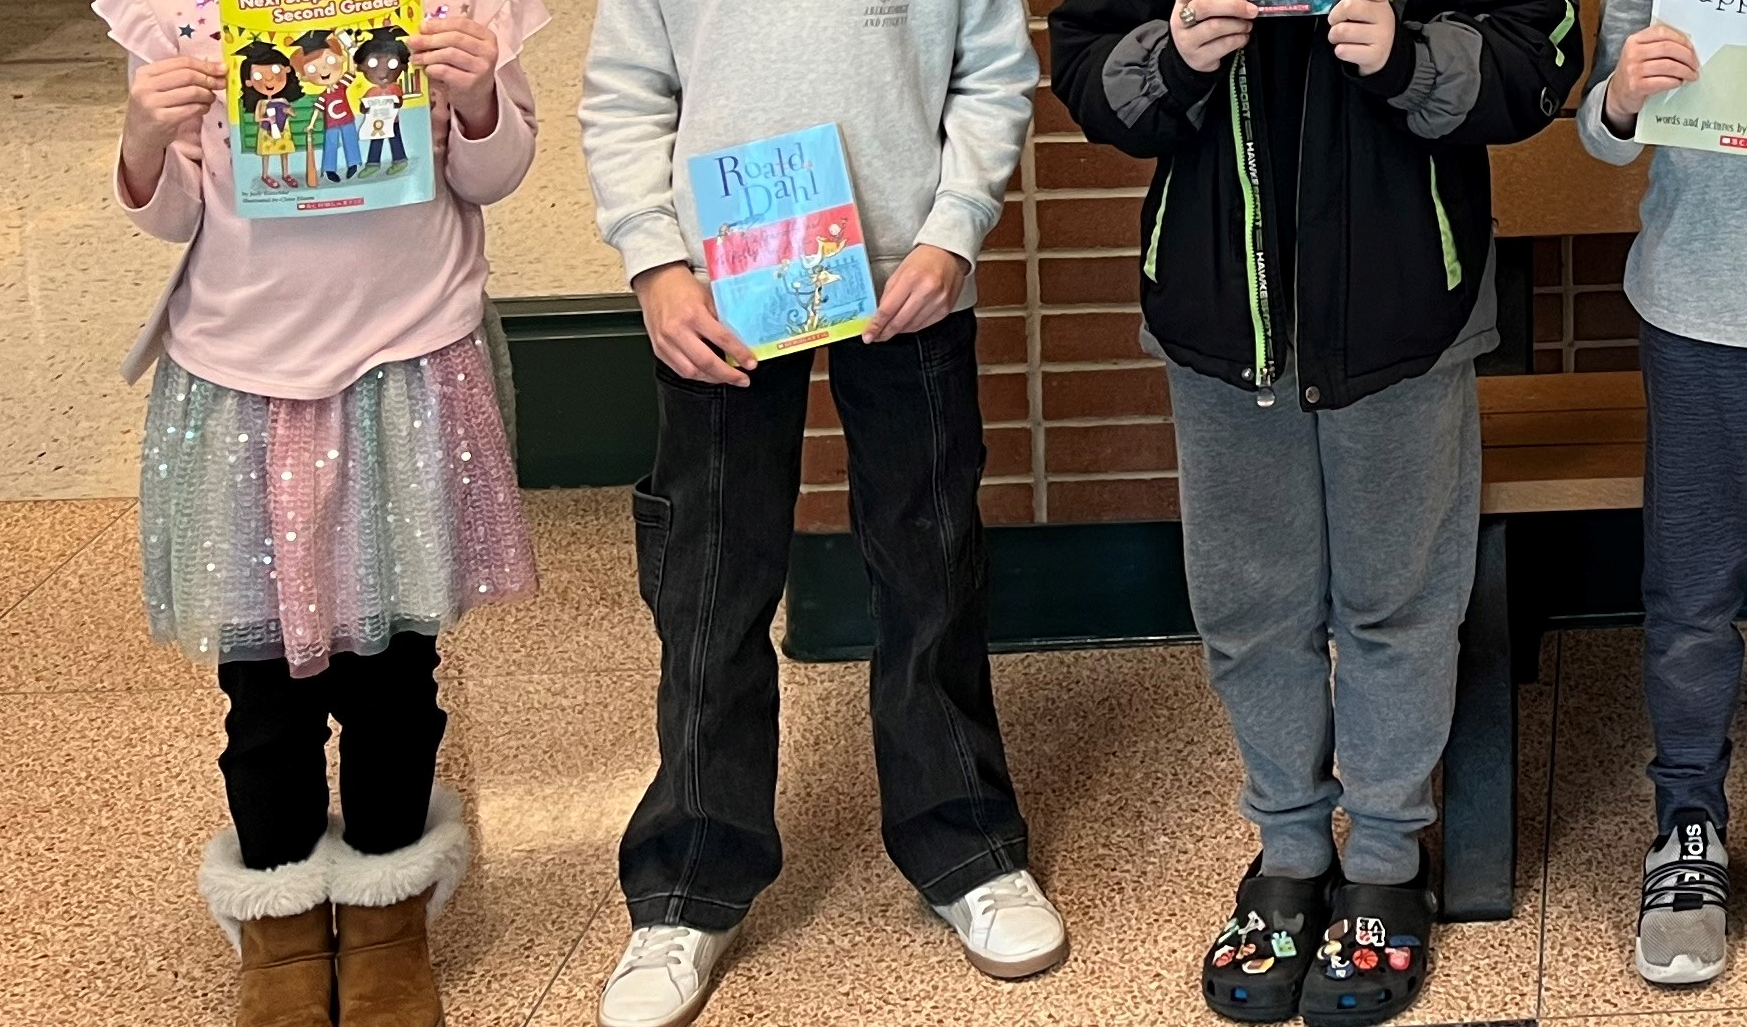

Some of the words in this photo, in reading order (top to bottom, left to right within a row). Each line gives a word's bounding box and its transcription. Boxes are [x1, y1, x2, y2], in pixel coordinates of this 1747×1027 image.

[273, 1, 336, 23] Second
[328, 100, 347, 119] C
[1655, 115, 1681, 126] words
[1683, 118, 1699, 128] and
[1700, 120, 1734, 132] pictures
[1737, 123, 1747, 135] by
[714, 142, 806, 198] Roald
[743, 171, 820, 216] Dahl
